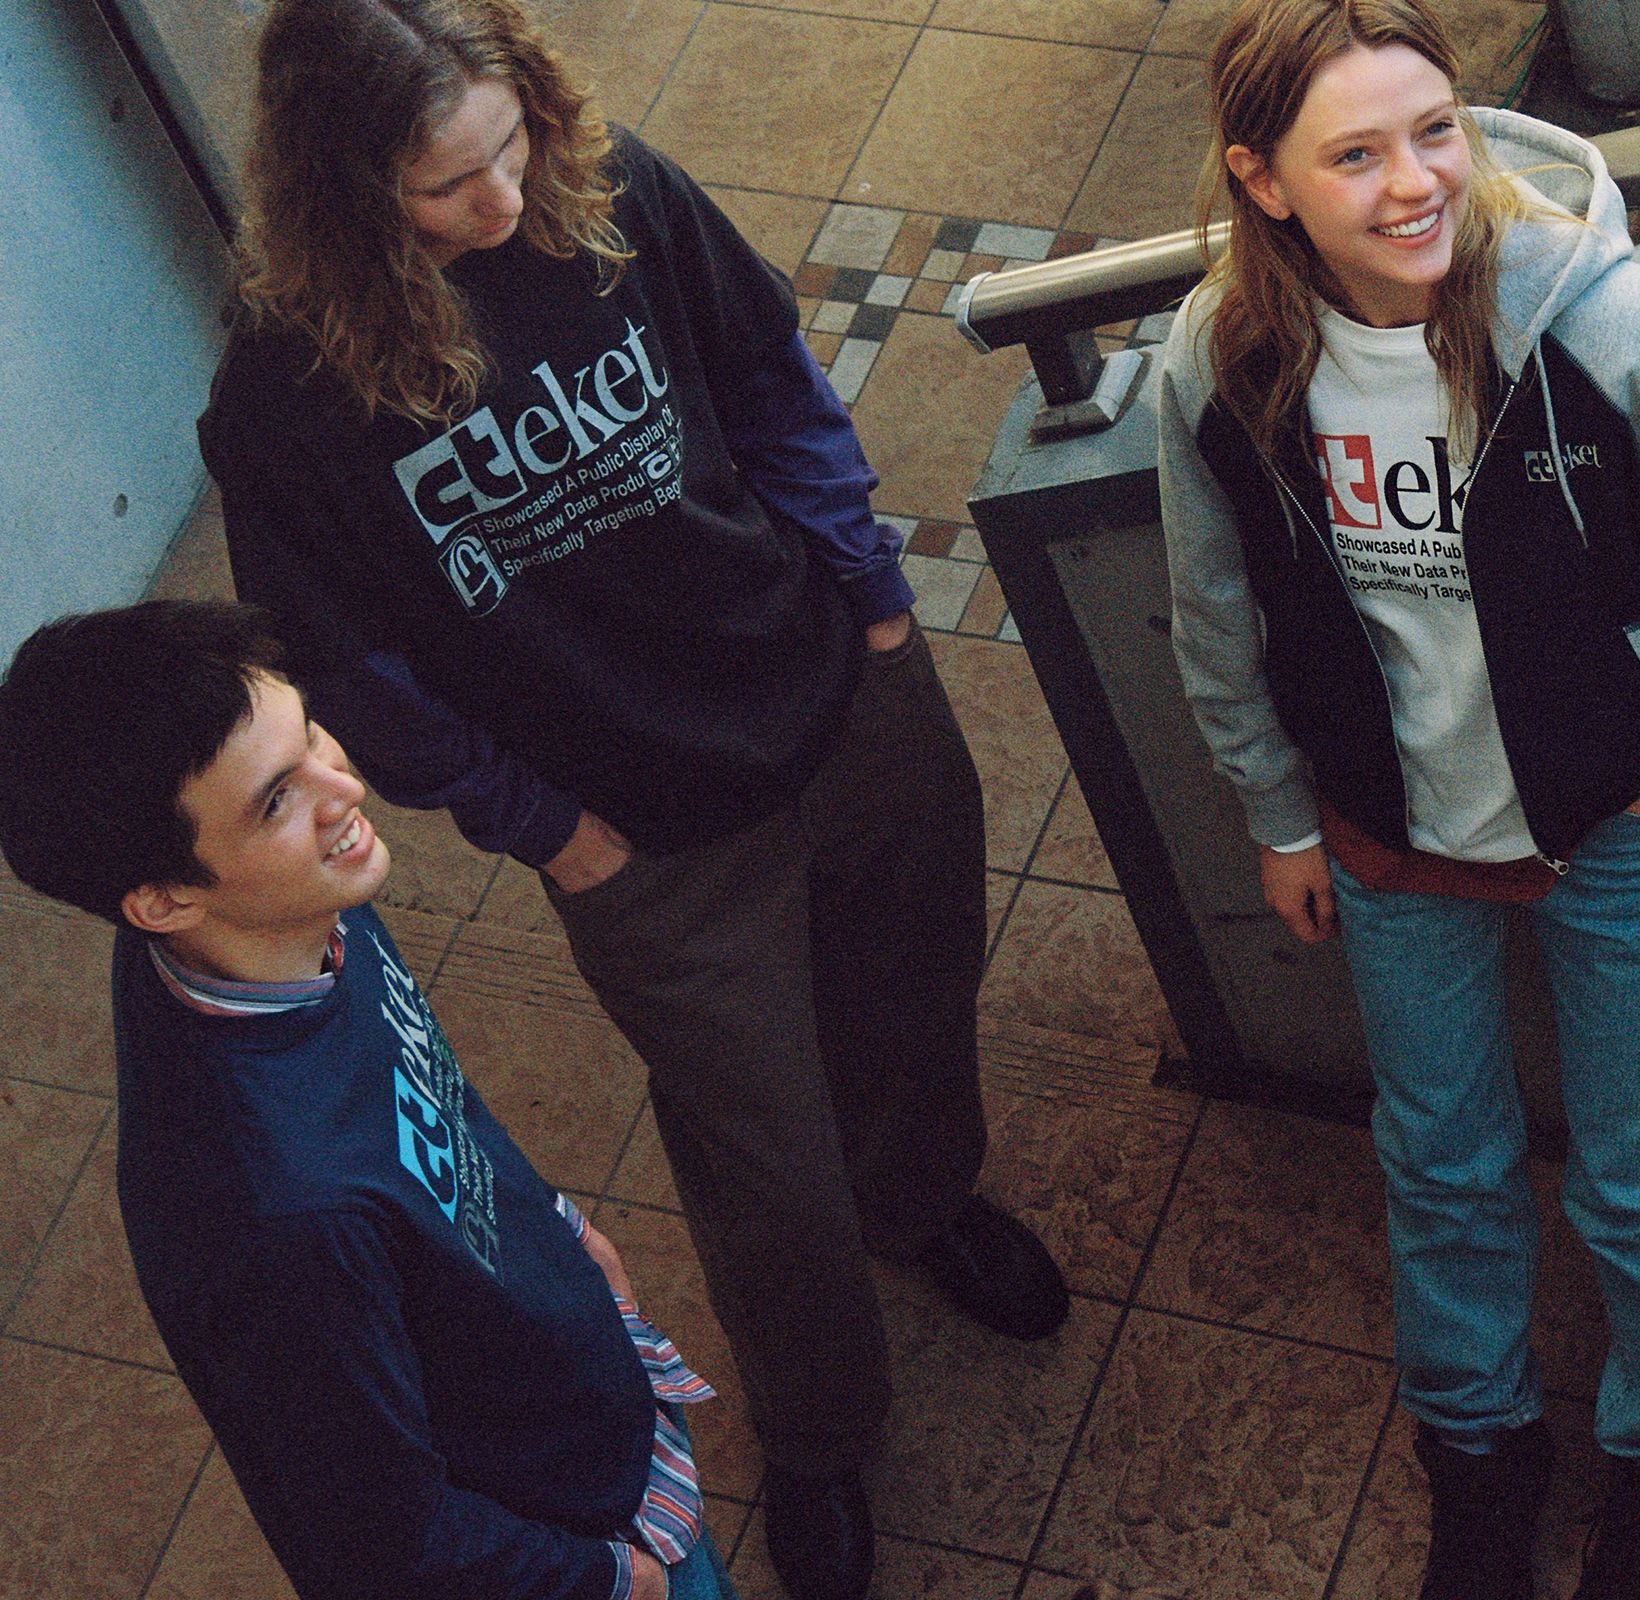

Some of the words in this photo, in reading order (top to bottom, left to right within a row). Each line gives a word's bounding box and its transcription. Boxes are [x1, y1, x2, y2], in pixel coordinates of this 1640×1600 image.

[483, 481, 564, 533] Showcased
[566, 475, 579, 492] A
[578, 451, 624, 486] Public
[620, 420, 667, 462] Display
[490, 533, 531, 554] Their
[533, 515, 565, 542] New
[564, 495, 599, 521] Data
[599, 473, 646, 503] Produ
[502, 529, 585, 577] Specifically
[584, 499, 656, 537] Targeting
[1336, 532, 1417, 556] Showcased
[1420, 539, 1431, 558] A
[1433, 541, 1462, 559] Pub
[1342, 554, 1378, 574] Their
[1379, 560, 1411, 578] New
[1414, 563, 1449, 579] Data
[1350, 576, 1429, 600] Specifically
[1430, 583, 1473, 602] Targe
